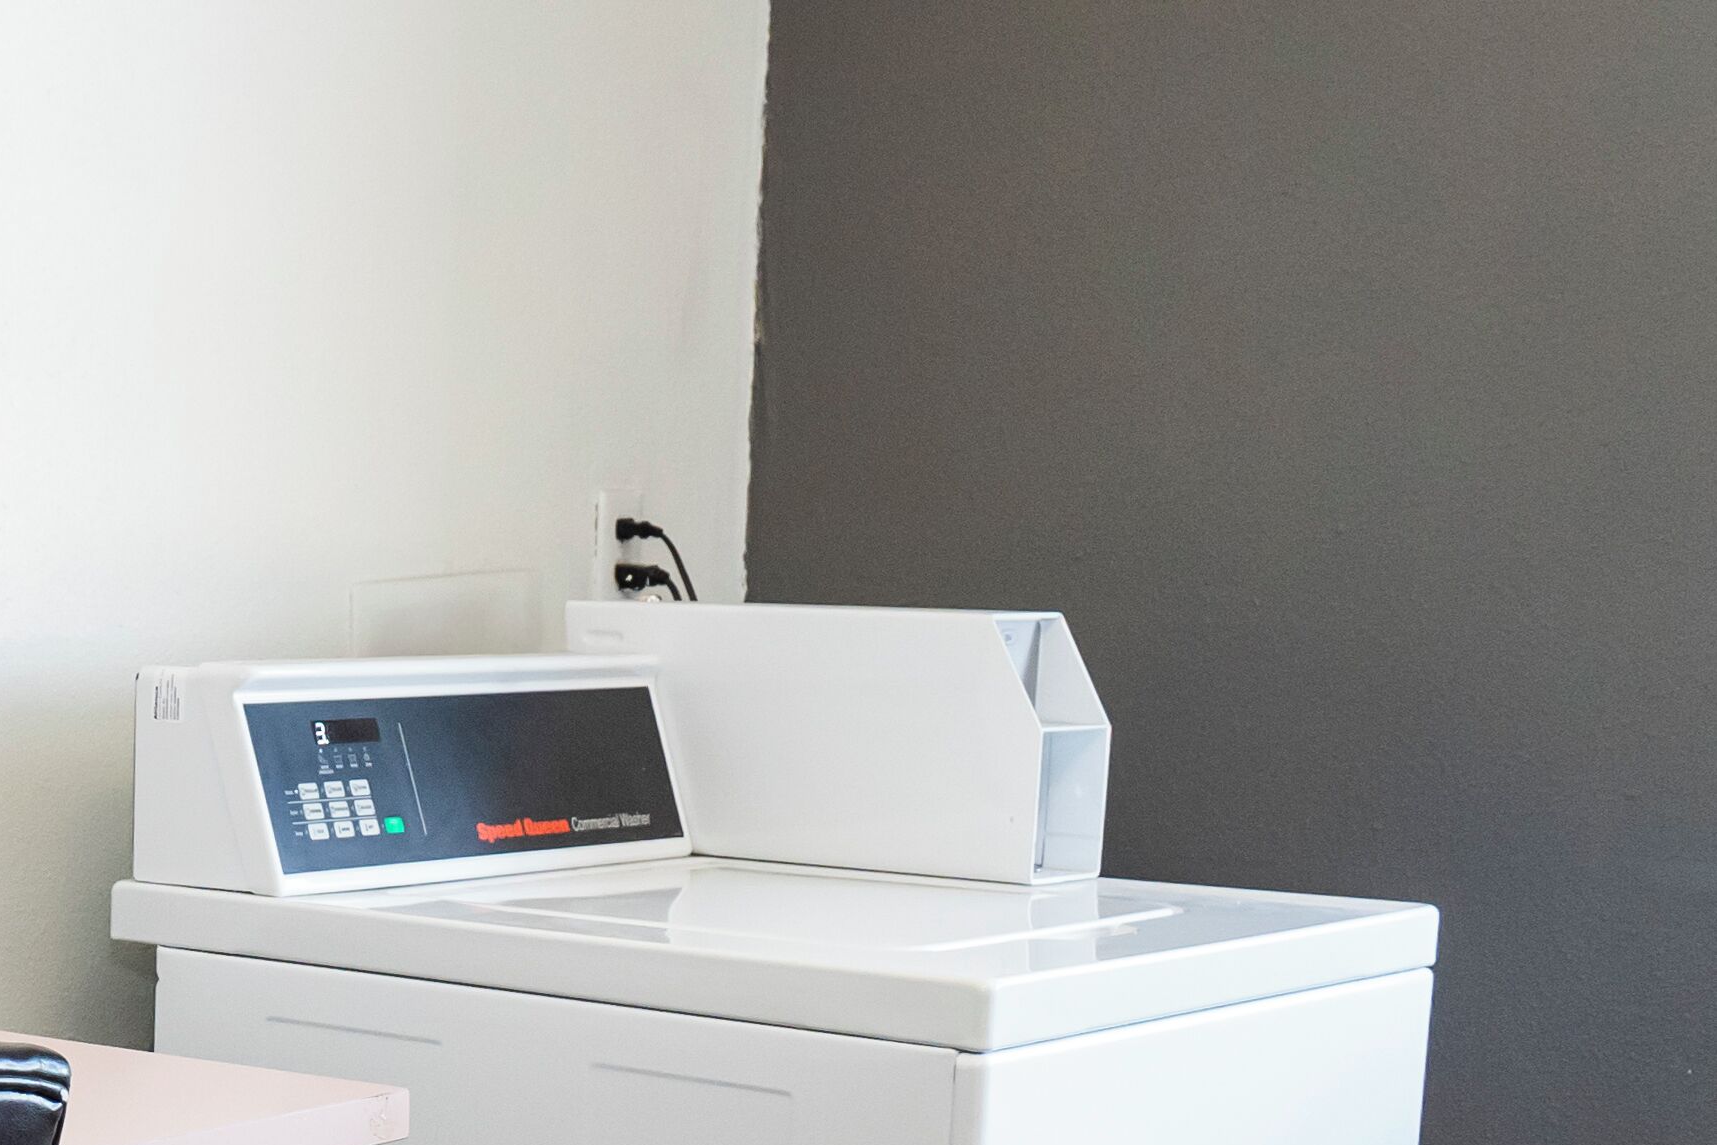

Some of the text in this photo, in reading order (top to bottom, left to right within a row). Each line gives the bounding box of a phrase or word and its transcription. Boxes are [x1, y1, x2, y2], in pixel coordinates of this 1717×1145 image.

[476, 811, 651, 844] Speed Queen Commercial Washer
